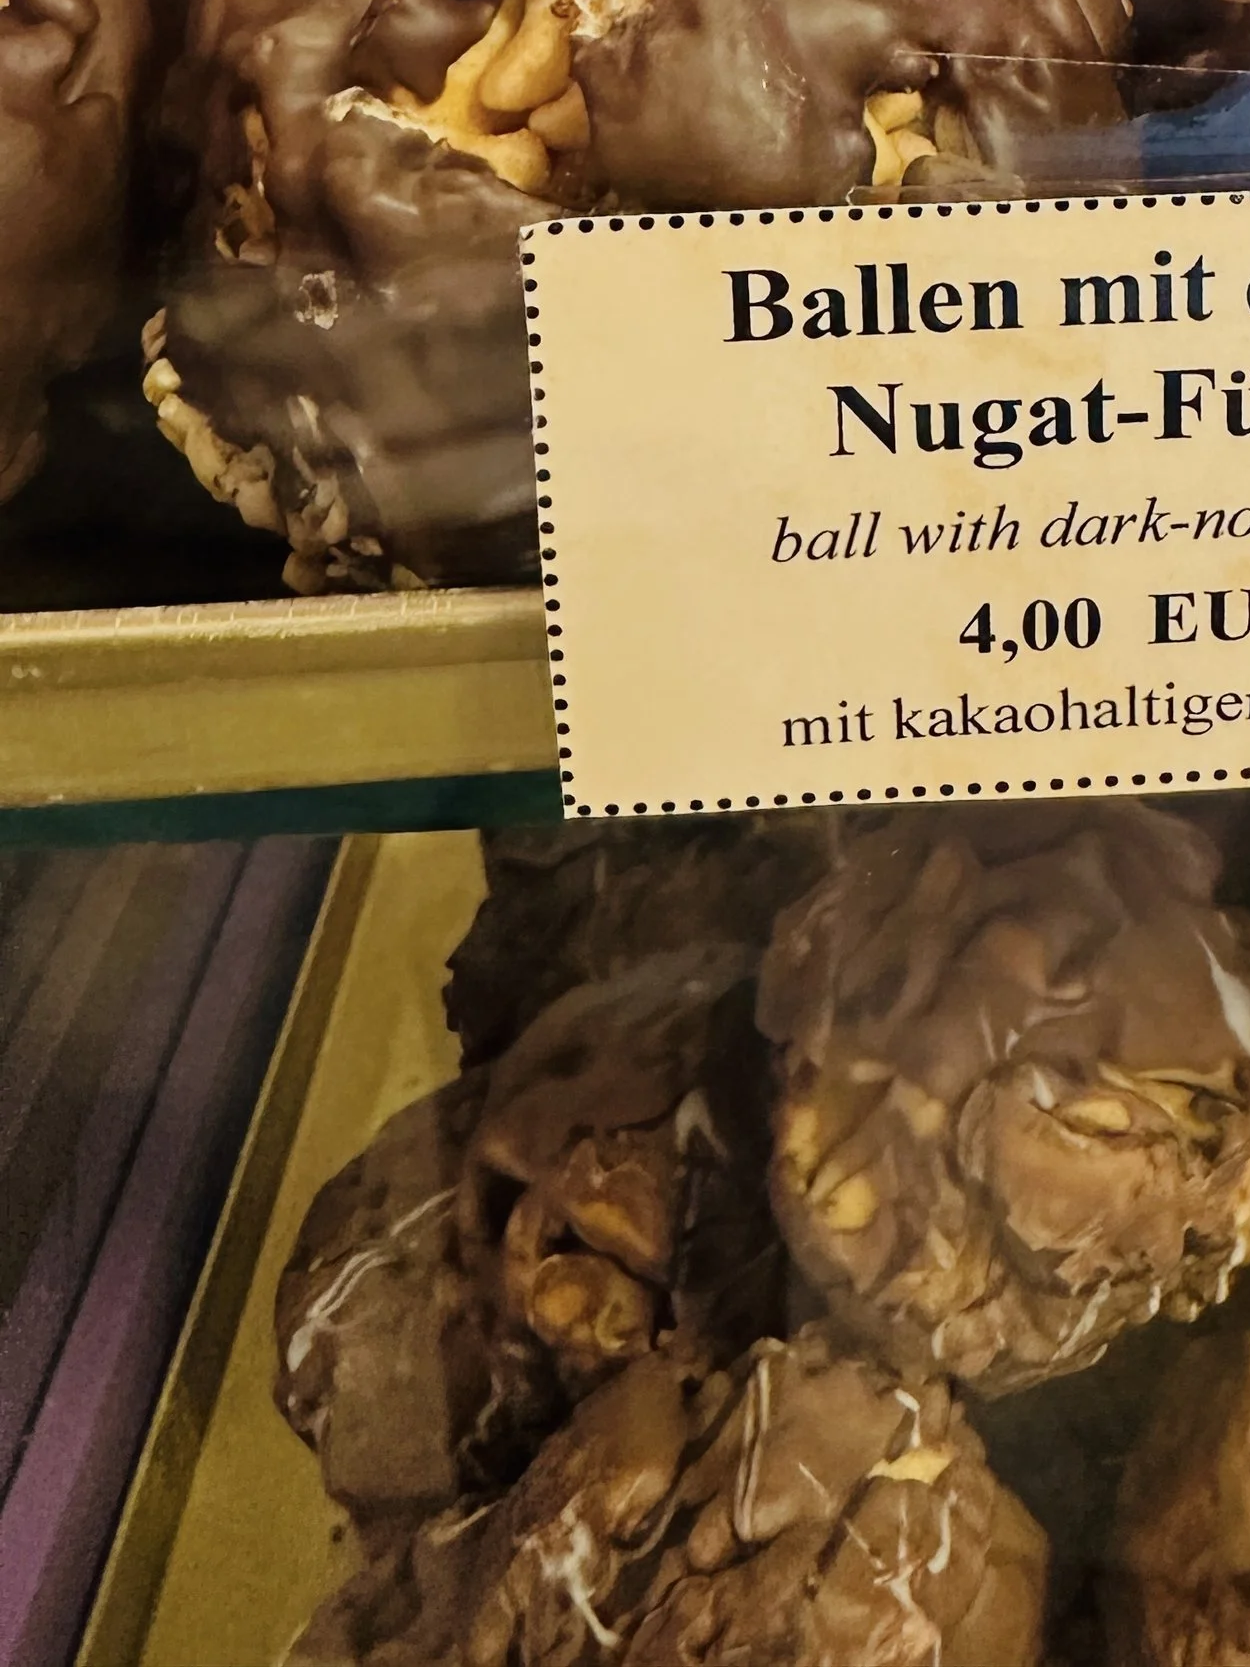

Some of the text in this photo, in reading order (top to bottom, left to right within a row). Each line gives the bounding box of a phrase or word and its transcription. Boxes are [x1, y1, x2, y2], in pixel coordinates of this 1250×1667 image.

[722, 262, 1024, 343] Ballen
[1060, 248, 1216, 327] mit
[771, 511, 882, 564] ball
[899, 503, 1020, 555] with
[959, 597, 1102, 664] 4,00
[783, 704, 875, 747] mit
